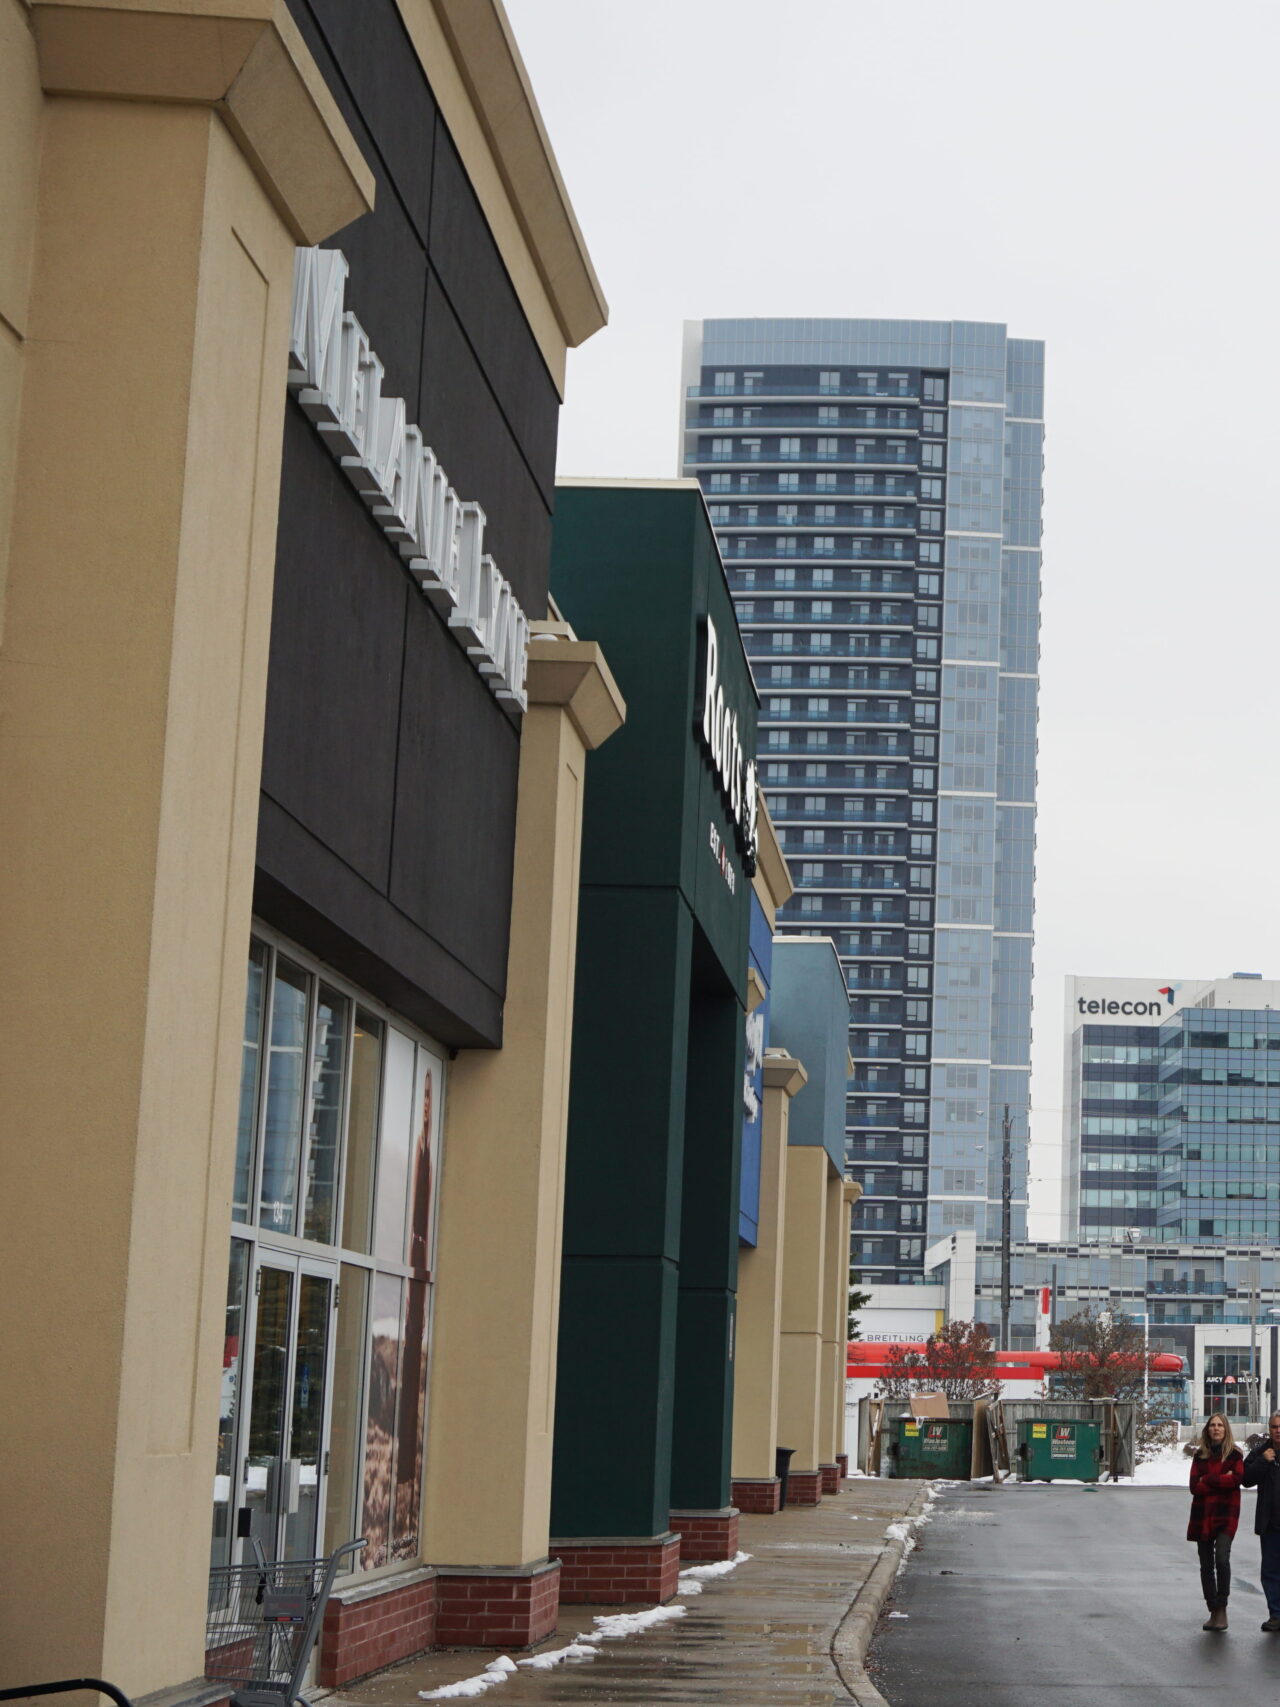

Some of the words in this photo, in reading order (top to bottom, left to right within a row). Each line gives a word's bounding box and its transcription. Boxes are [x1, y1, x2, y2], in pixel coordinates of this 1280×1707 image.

[703, 612, 742, 825] Roots
[1078, 997, 1161, 1016] telecon
[867, 1334, 924, 1342] BREITLING
